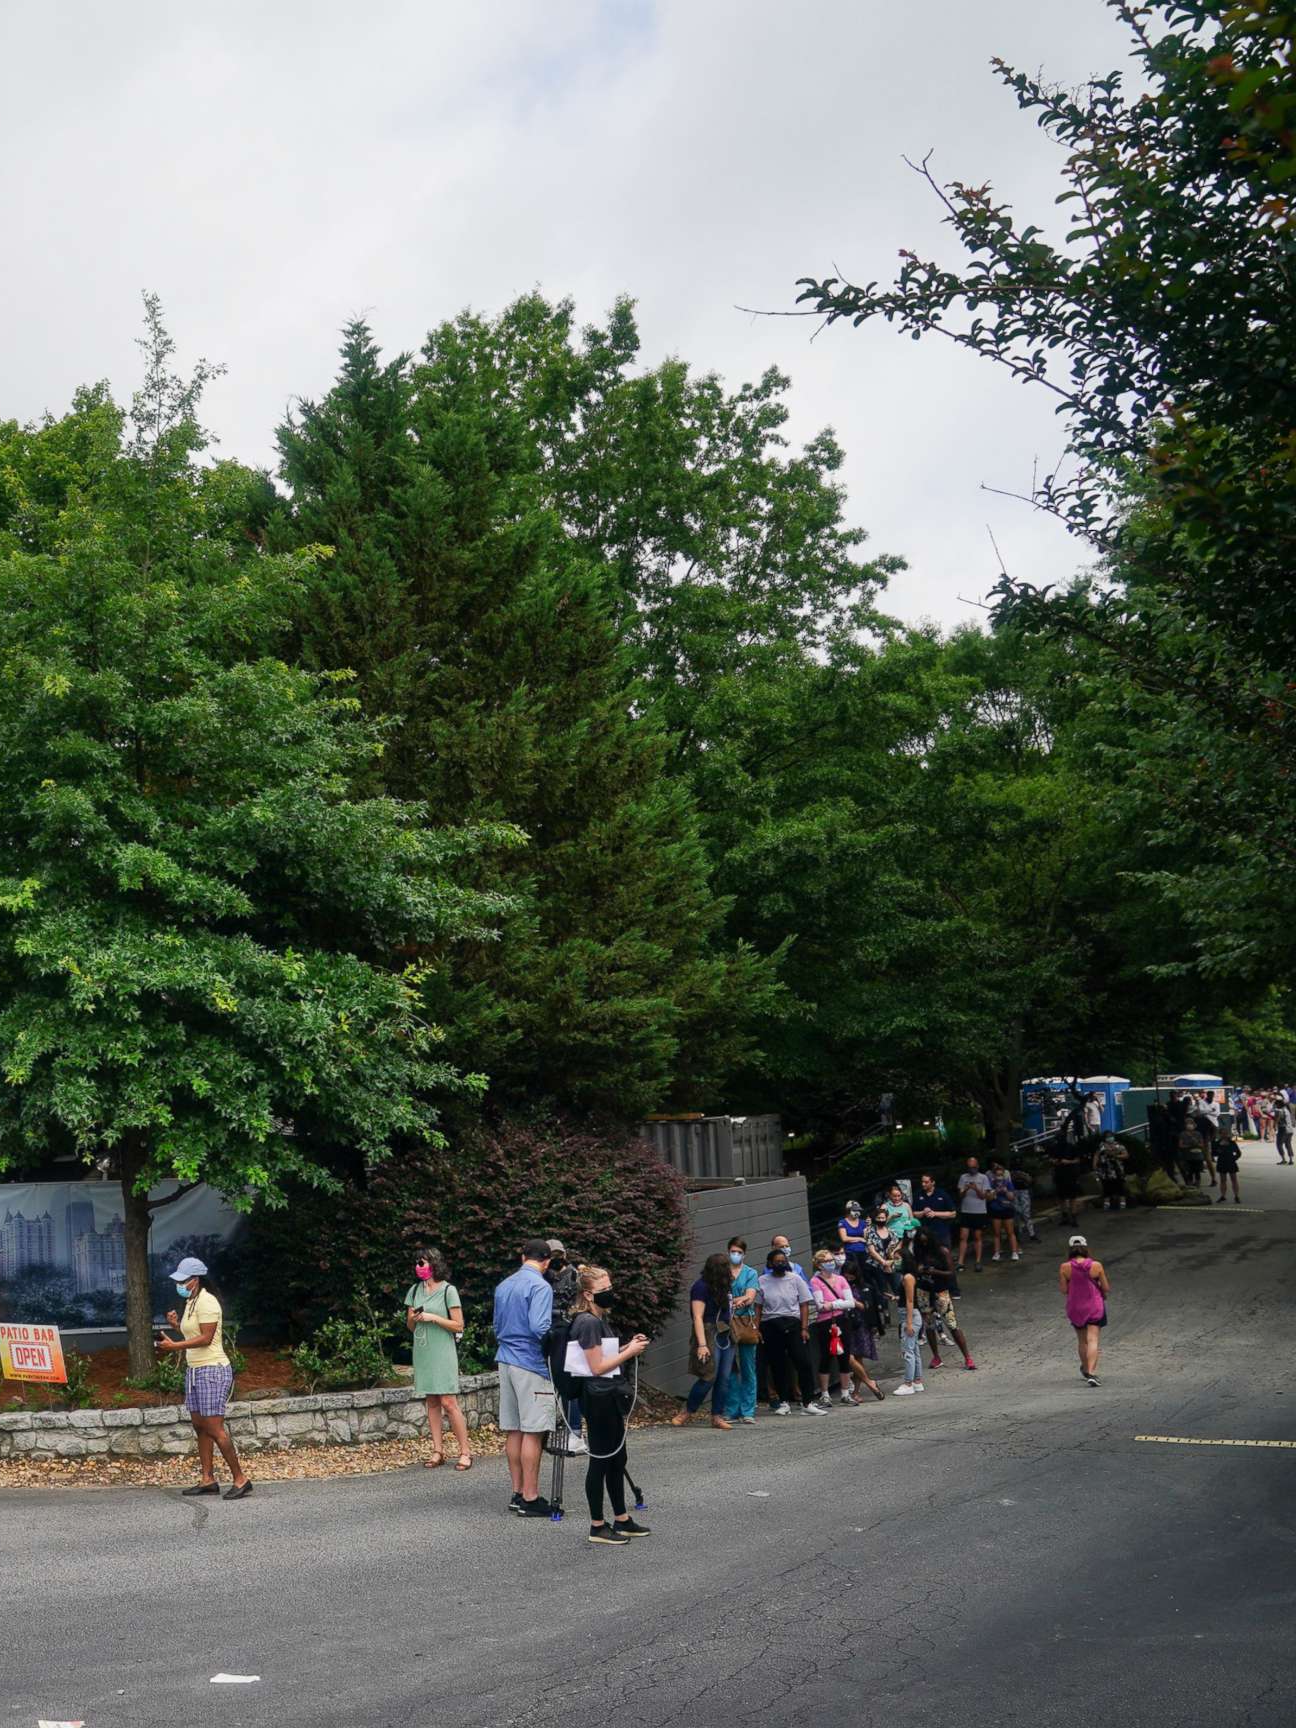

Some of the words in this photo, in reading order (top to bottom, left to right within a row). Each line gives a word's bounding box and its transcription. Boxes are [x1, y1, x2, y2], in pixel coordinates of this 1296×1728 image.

[0, 1326, 29, 1340] PATIO
[33, 1328, 54, 1342] BAR
[15, 1347, 47, 1367] OPEN
